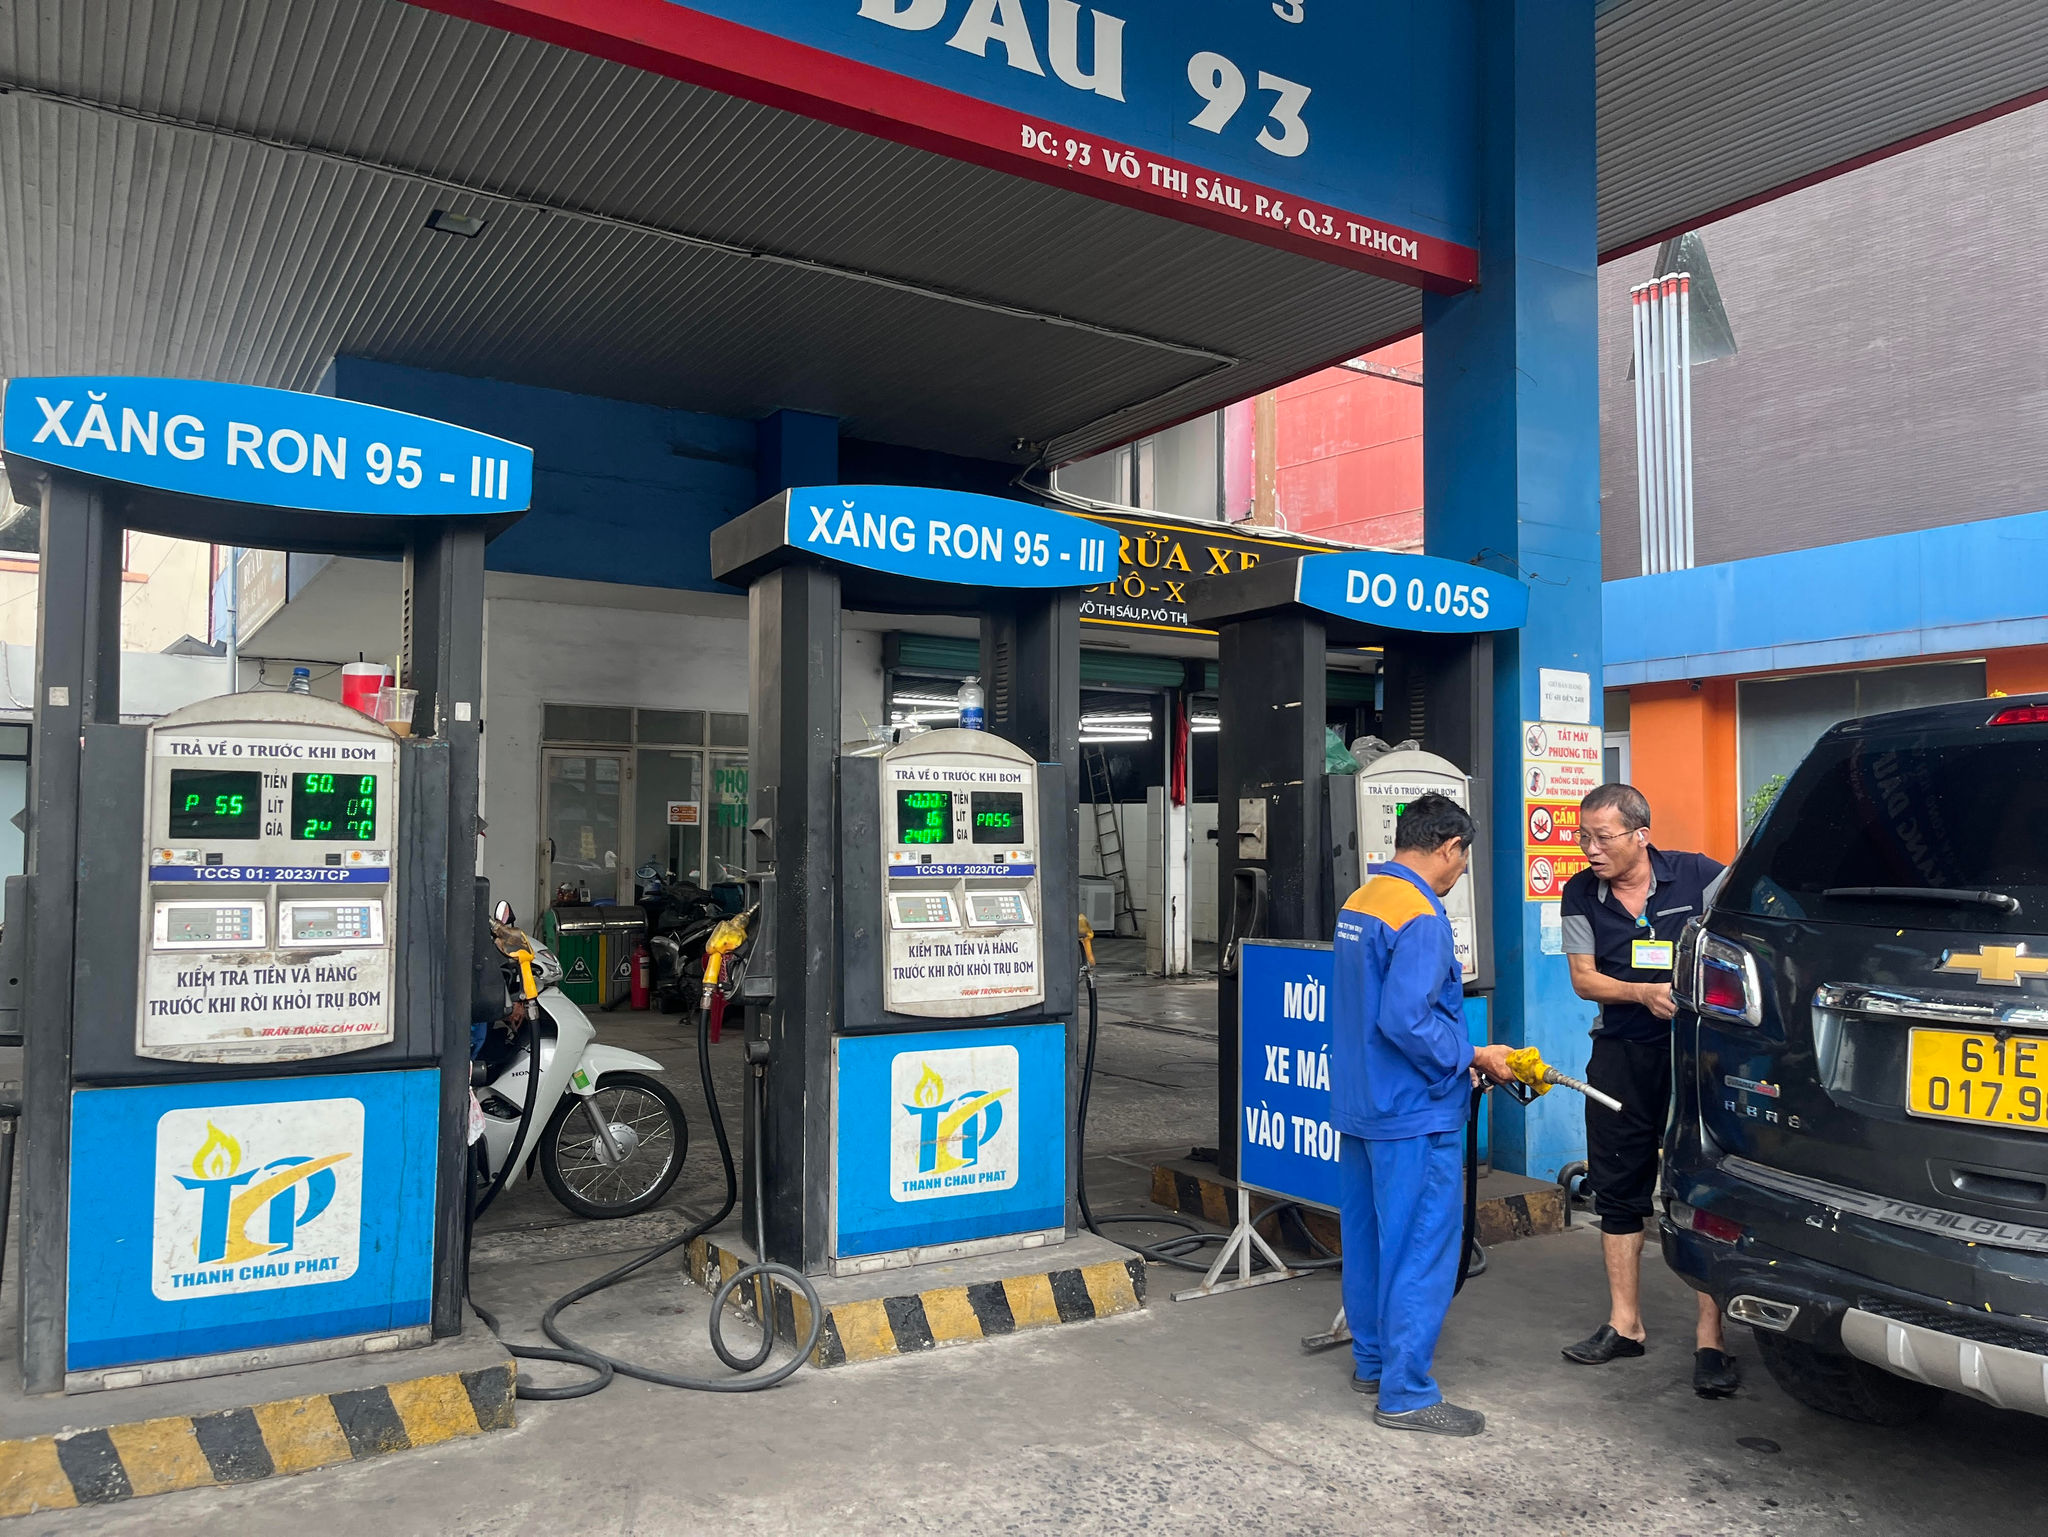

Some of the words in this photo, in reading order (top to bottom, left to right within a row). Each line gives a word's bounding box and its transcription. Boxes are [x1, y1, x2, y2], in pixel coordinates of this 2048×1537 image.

[1187, 51, 1312, 157] 93
[1021, 125, 1058, 156] ĐC:
[1065, 139, 1091, 165] 93
[1102, 148, 1141, 178] VÕ
[1147, 162, 1188, 198] THỊ
[1196, 178, 1248, 212] SÁU,
[1255, 195, 1292, 224] P.6,
[1298, 209, 1341, 240] Q.3,
[1346, 221, 1418, 261] TP.HCM
[33, 391, 205, 461] XĂNG
[227, 422, 347, 480] RON
[365, 442, 422, 489] 95
[439, 472, 455, 483] -
[470, 456, 508, 500] III
[807, 499, 915, 553] XĂNG
[928, 520, 1002, 562] RON
[1014, 531, 1050, 567] 95
[1059, 552, 1071, 561] -
[1079, 538, 1105, 572] III
[1118, 531, 1192, 573] RỬA
[1346, 569, 1397, 608] DO
[1407, 578, 1490, 620] 0.05S
[1098, 604, 1115, 617] THỊ
[171, 739, 203, 755] TRẢ
[208, 740, 228, 756] VỀ
[248, 742, 303, 758] TRƯỚC
[309, 746, 336, 759] KHI
[342, 747, 376, 760] BƠM
[895, 767, 915, 780] TRẢ
[942, 770, 976, 782] TRƯỚC
[979, 772, 997, 782] KHI
[976, 812, 1011, 828] PASS
[1553, 806, 1576, 824] CẤM
[1559, 829, 1572, 841] NO
[194, 868, 241, 880] TCCS
[246, 868, 270, 880] 01:
[275, 868, 350, 881] 2023/TCP
[916, 866, 944, 875] TCCS
[946, 866, 962, 875] 01:
[964, 866, 1010, 875] 2023/TCP
[934, 945, 952, 957] TRA
[177, 965, 215, 988] KIỂM
[220, 970, 249, 986] TRA
[254, 965, 287, 985] TIỀN
[291, 965, 311, 984] VÀ
[315, 966, 358, 983] HÀNG
[893, 963, 925, 979] TRƯỚC
[928, 965, 945, 978] KHI
[967, 959, 991, 975] KHỎI
[993, 962, 1011, 977] TRỤ
[1014, 960, 1034, 974] BƠM
[149, 995, 204, 1016] TRƯỚC
[208, 998, 235, 1013] KHI
[241, 991, 268, 1012] RỜI
[273, 989, 312, 1011] KHỎI
[316, 993, 344, 1012] TRỤ
[348, 990, 381, 1007] BƠM
[1283, 974, 1325, 1023] MỜI
[1264, 1044, 1290, 1085] XE
[1297, 1044, 1334, 1092] MÁ
[1961, 1038, 2038, 1079] 61E
[1929, 1077, 2048, 1123] 017.9
[1246, 1100, 1285, 1150] VÀO
[1886, 1200, 2048, 1243] TRAILBLA
[171, 1268, 234, 1288] THANH
